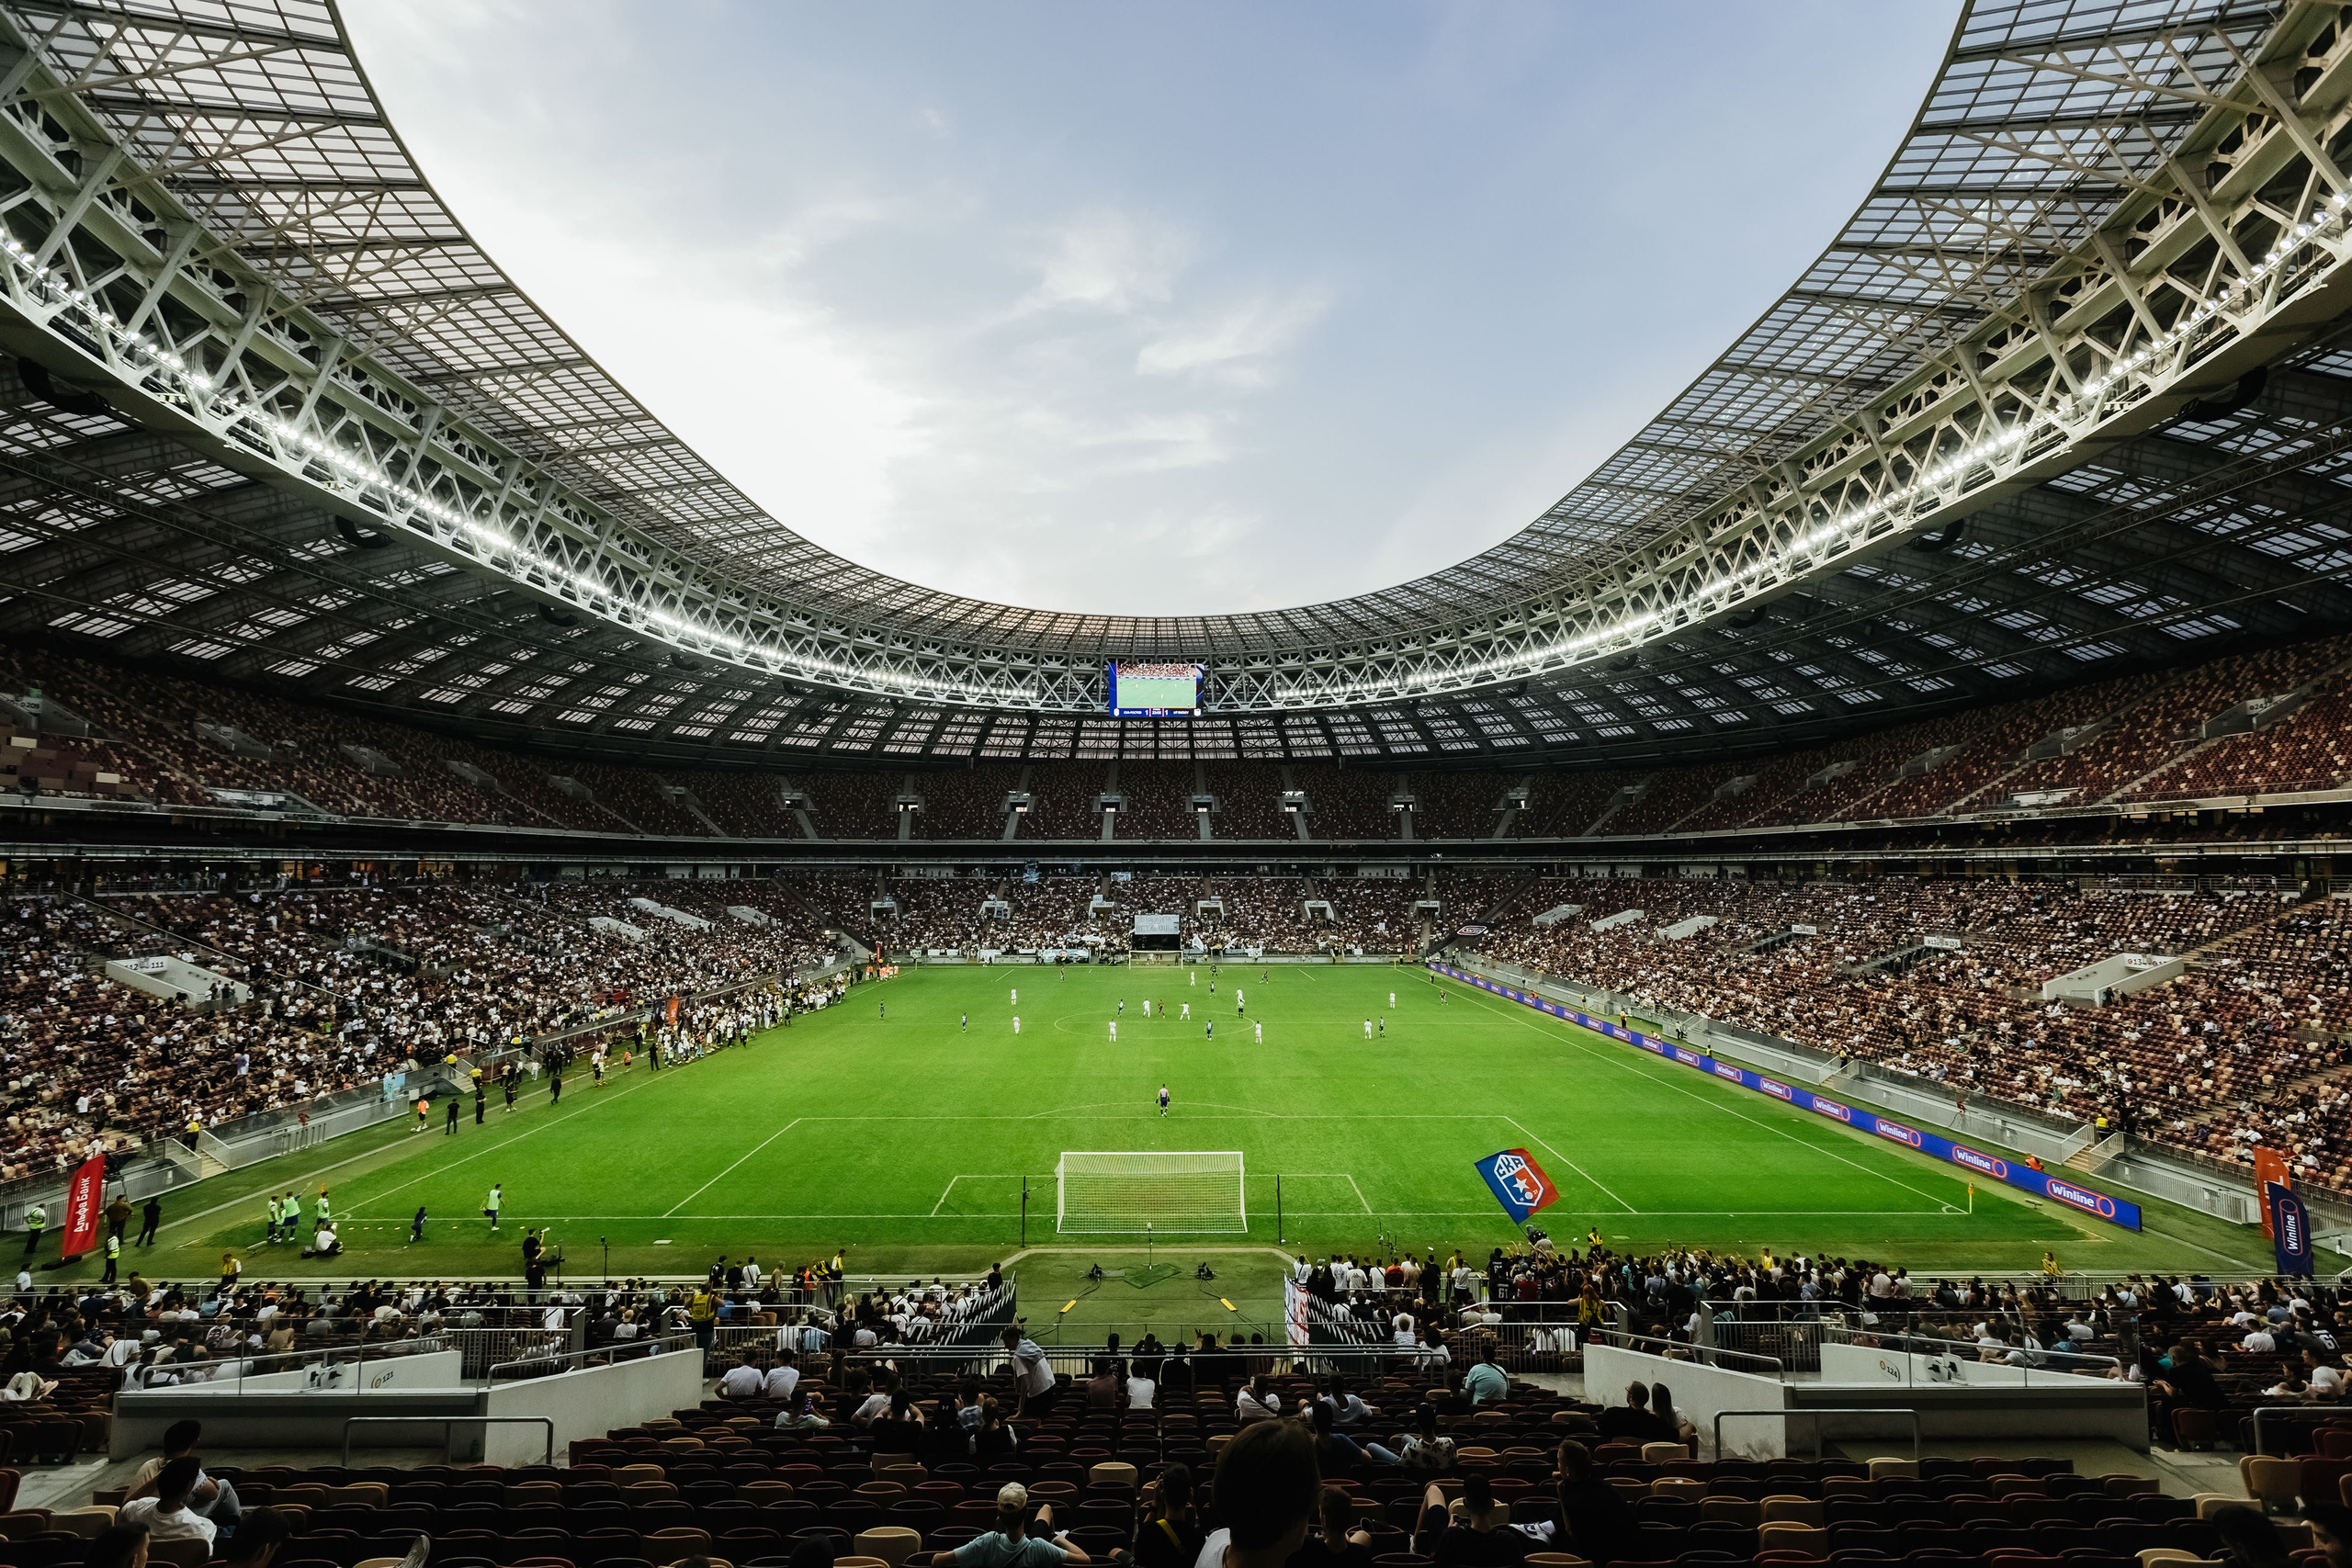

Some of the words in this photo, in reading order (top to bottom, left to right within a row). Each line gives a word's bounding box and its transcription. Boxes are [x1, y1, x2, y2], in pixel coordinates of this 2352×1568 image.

[1644, 1039, 1657, 1049] Winline
[1677, 1051, 1693, 1062] Winline
[1716, 1065, 1735, 1077] Winline
[1762, 1080, 1783, 1095] Winline
[1815, 1100, 1839, 1115] Winline
[1879, 1122, 1908, 1140] Winline
[1956, 1149, 1991, 1169] Winline
[76, 1177, 91, 1201] Банк
[2052, 1183, 2095, 1207] Winline
[74, 1201, 89, 1233] Альфа
[2286, 1214, 2299, 1249] Winline
[1498, 1288, 1509, 1299] 61
[382, 1371, 394, 1383] 121
[1887, 1367, 1898, 1378] 124
